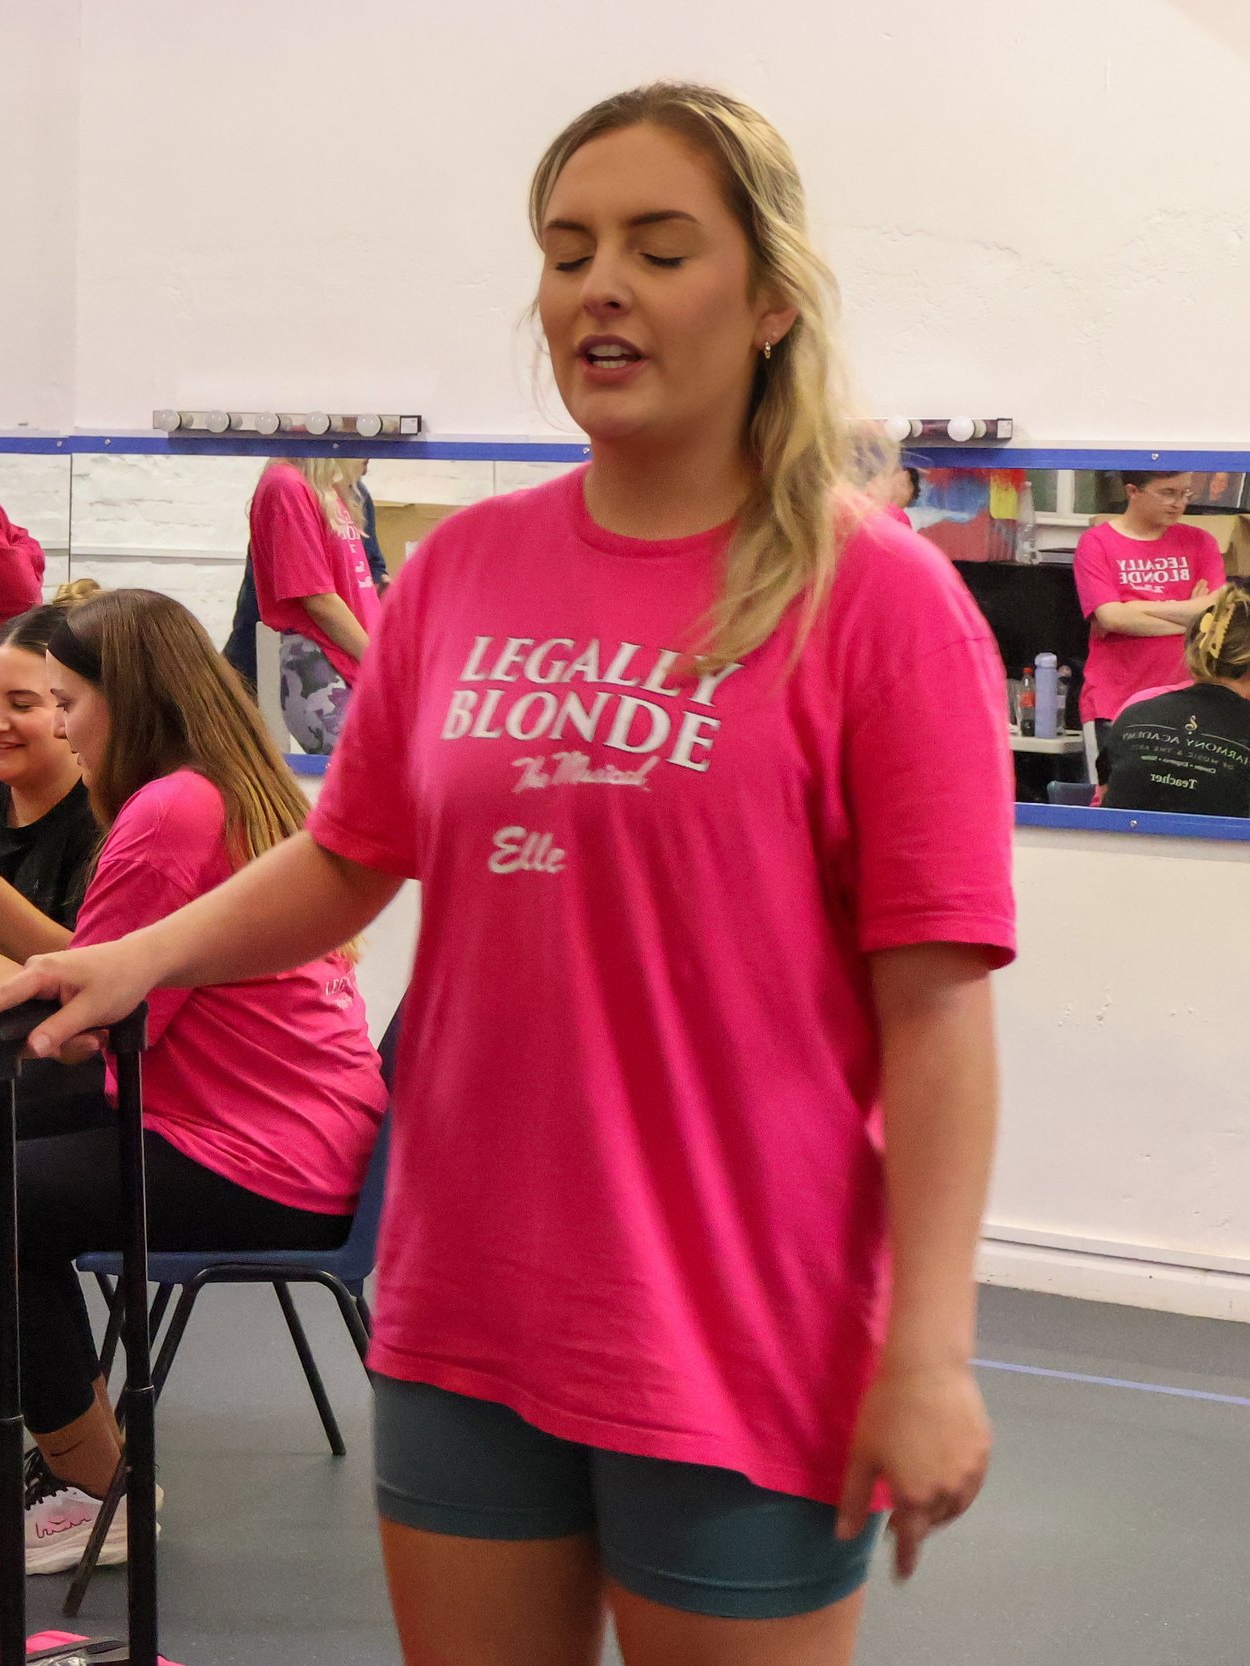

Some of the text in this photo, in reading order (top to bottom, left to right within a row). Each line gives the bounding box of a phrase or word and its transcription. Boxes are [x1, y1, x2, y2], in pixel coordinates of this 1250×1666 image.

[459, 635, 745, 708] LEGALLY
[441, 689, 722, 772] BLONDE
[488, 825, 566, 874] Elle
